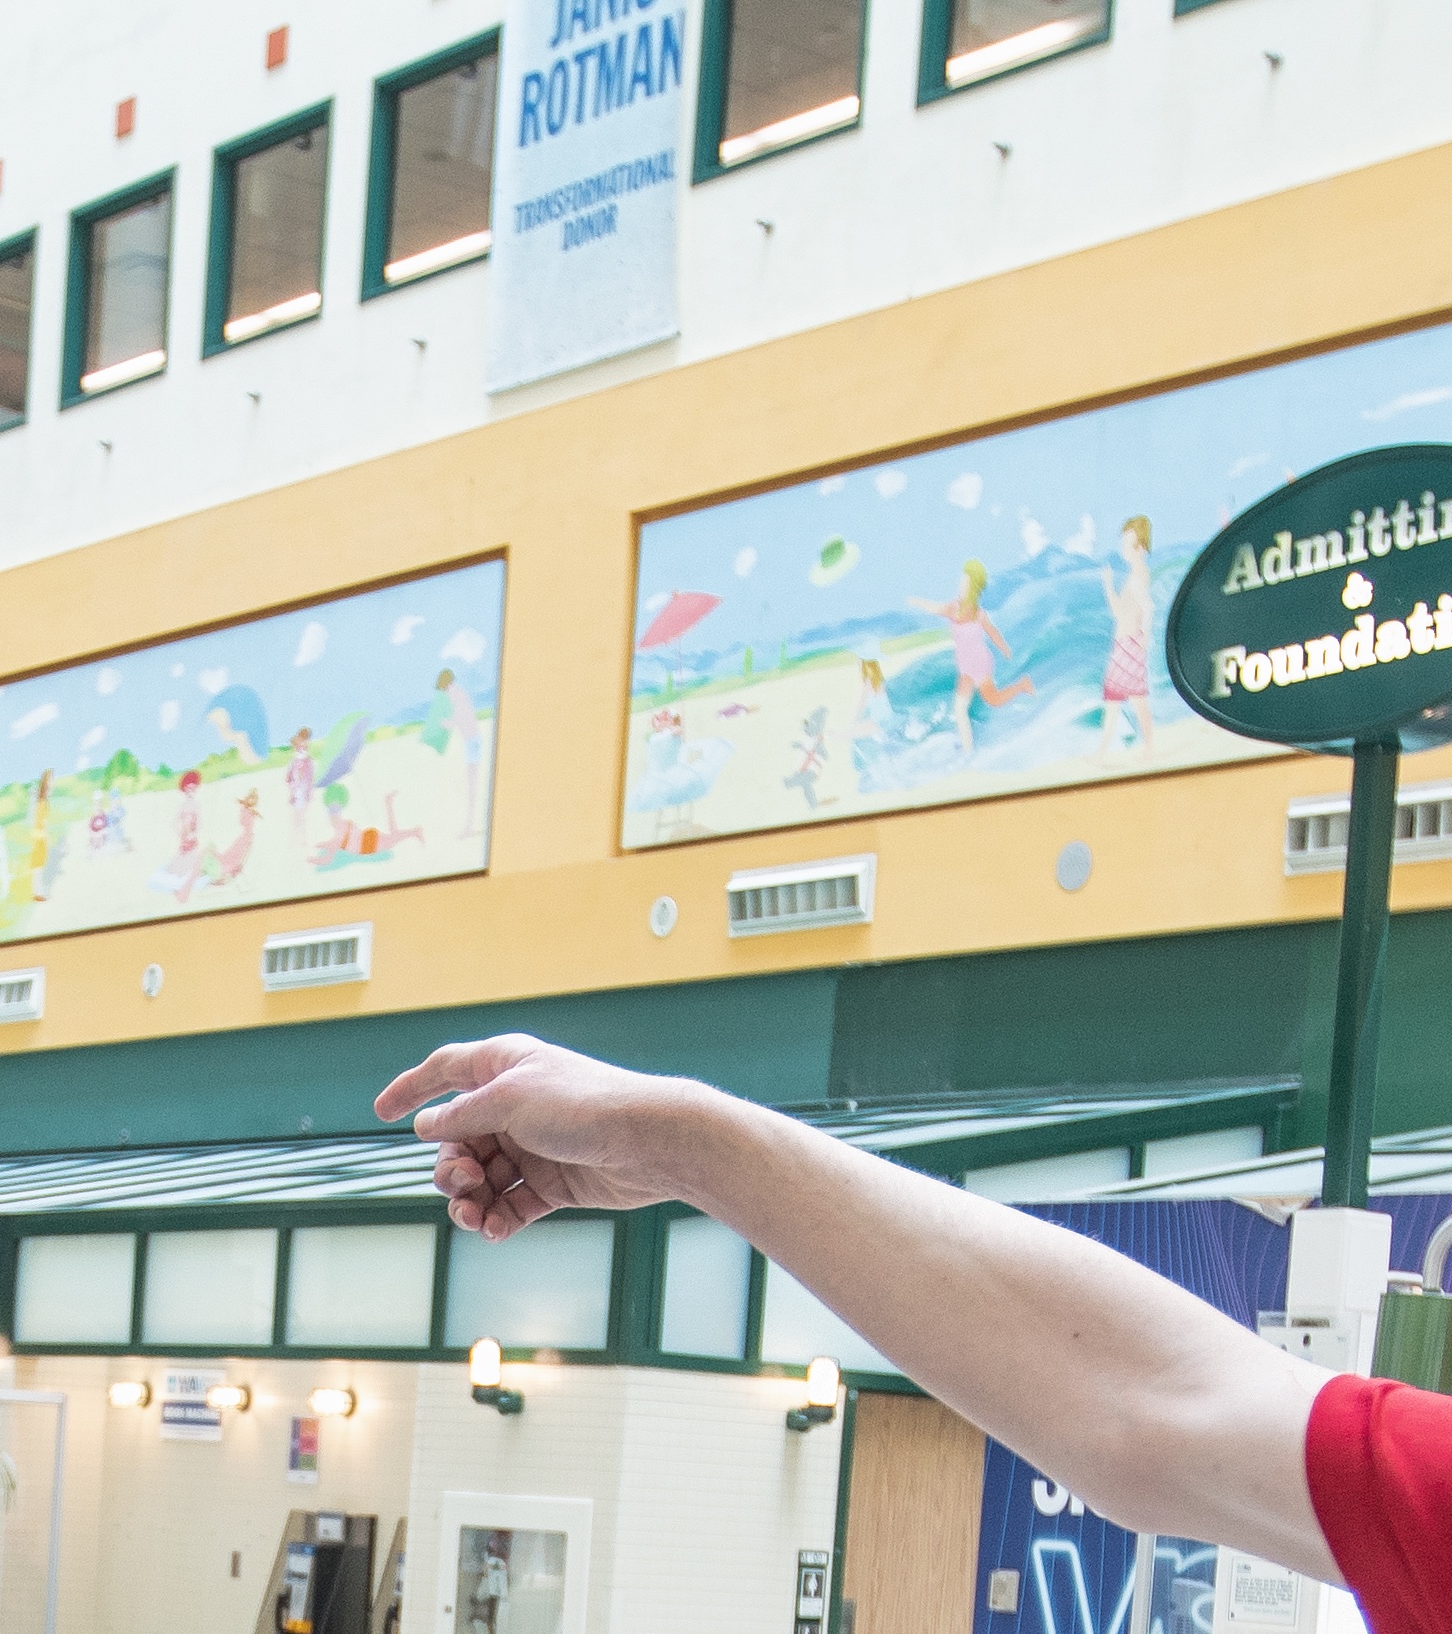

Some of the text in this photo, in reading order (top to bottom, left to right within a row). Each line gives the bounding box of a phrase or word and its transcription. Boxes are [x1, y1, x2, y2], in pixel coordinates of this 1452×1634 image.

[518, 10, 685, 147] ROTMAN
[515, 148, 674, 233] TRANSFORMATIONAL
[562, 203, 618, 251] DONOR
[1342, 571, 1374, 609] &
